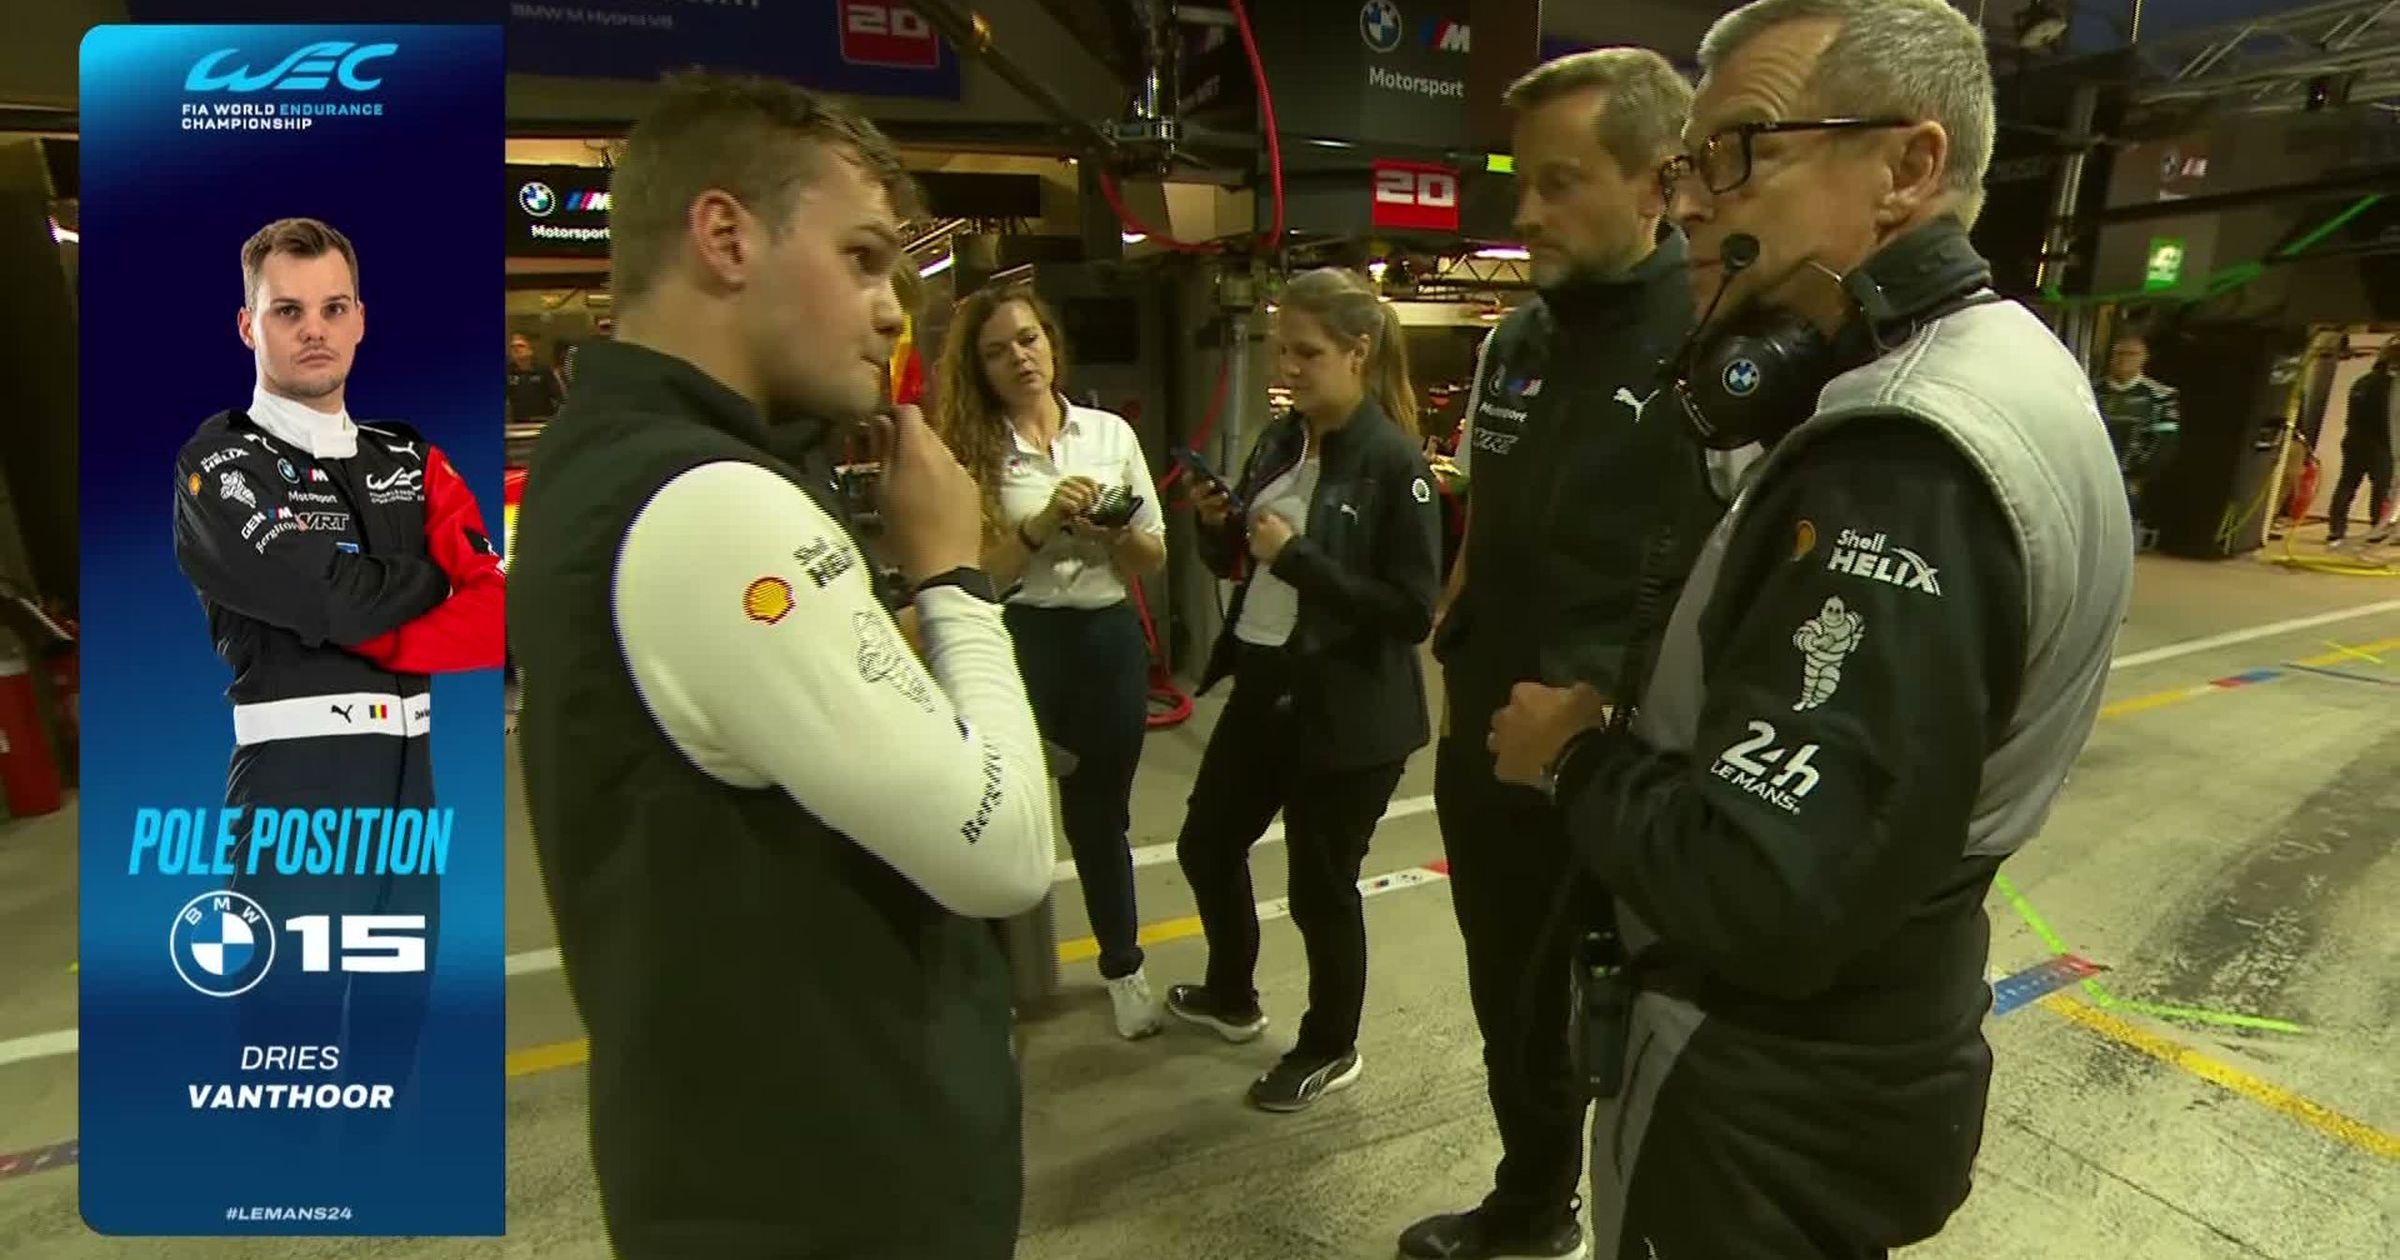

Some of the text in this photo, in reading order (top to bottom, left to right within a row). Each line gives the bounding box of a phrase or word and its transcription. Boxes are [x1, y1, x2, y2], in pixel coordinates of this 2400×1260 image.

[847, 4, 931, 39] 20
[1369, 65, 1465, 98] Motorsport
[1376, 169, 1456, 208] 20
[531, 224, 611, 241] Motorsport
[1836, 528, 1888, 553] Shell
[1827, 546, 1941, 597] HELIX
[1710, 759, 1737, 779] LE
